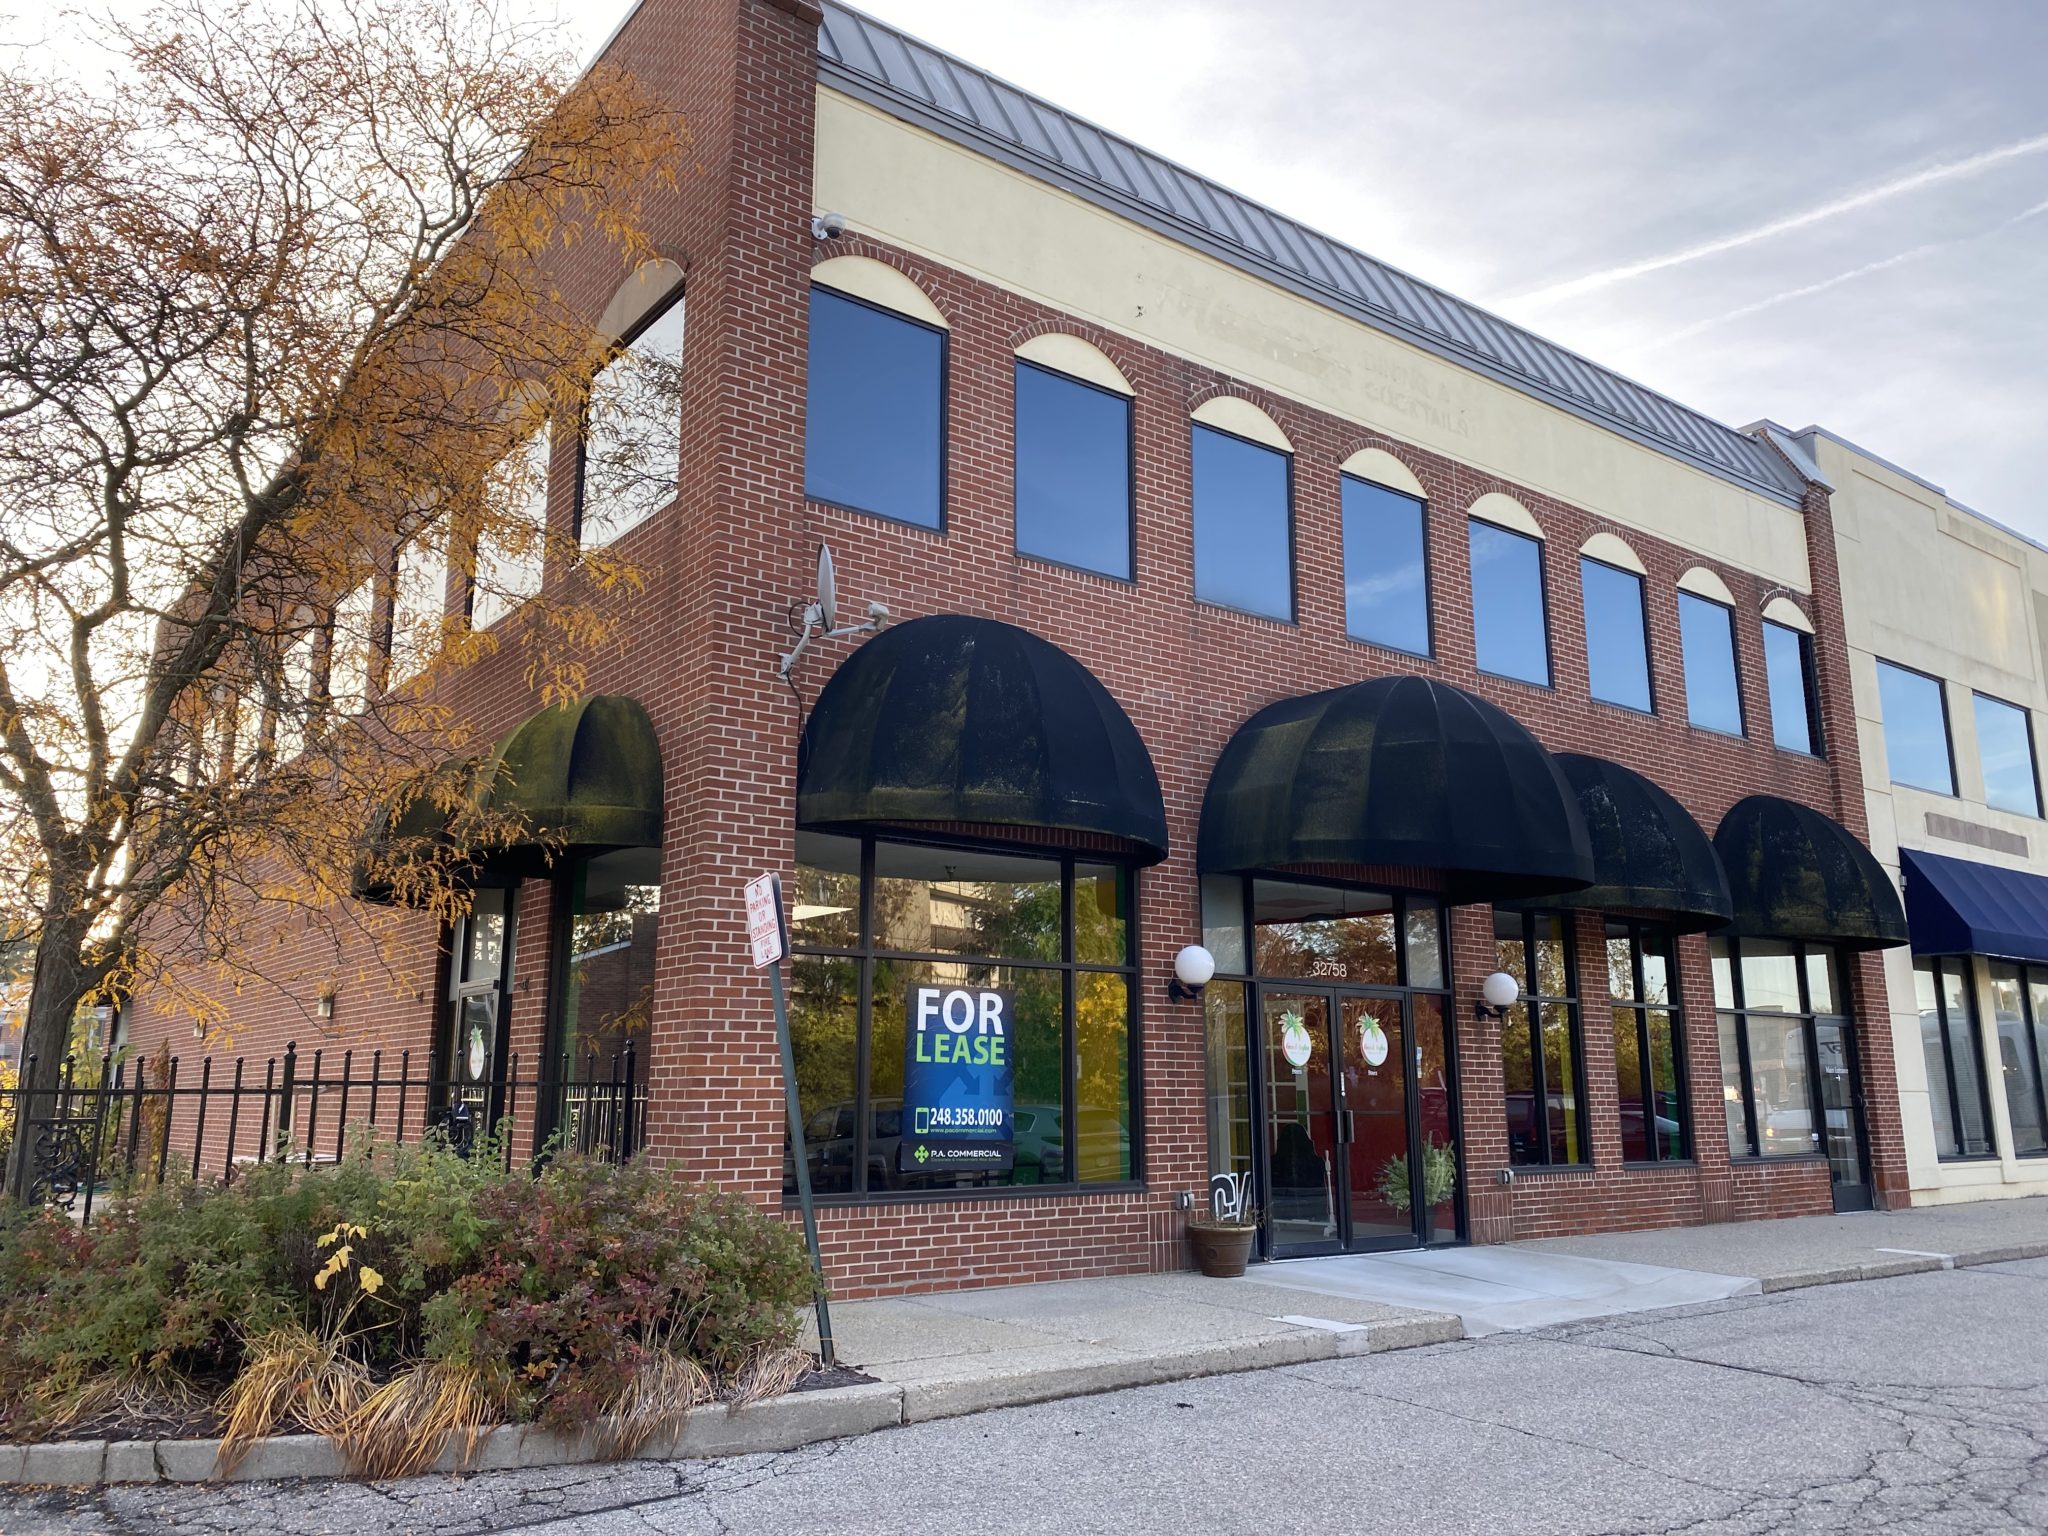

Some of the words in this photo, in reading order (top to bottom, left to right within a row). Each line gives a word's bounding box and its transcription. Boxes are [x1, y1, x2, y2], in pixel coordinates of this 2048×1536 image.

[755, 886, 763, 898] NO
[750, 894, 772, 913] PARKING
[758, 910, 766, 922] OR
[752, 918, 776, 939] STANDING
[760, 937, 771, 948] FIRE
[761, 946, 773, 959] LANE
[1312, 961, 1348, 977] 32758
[917, 987, 1004, 1035] FOR
[916, 1033, 1005, 1065] LEASE
[930, 1107, 1003, 1127] 248.358.0100
[930, 1127, 997, 1135] www.pacommercial.com
[930, 1149, 946, 1158] P.A.
[947, 1149, 1002, 1158] COMMERCIAL
